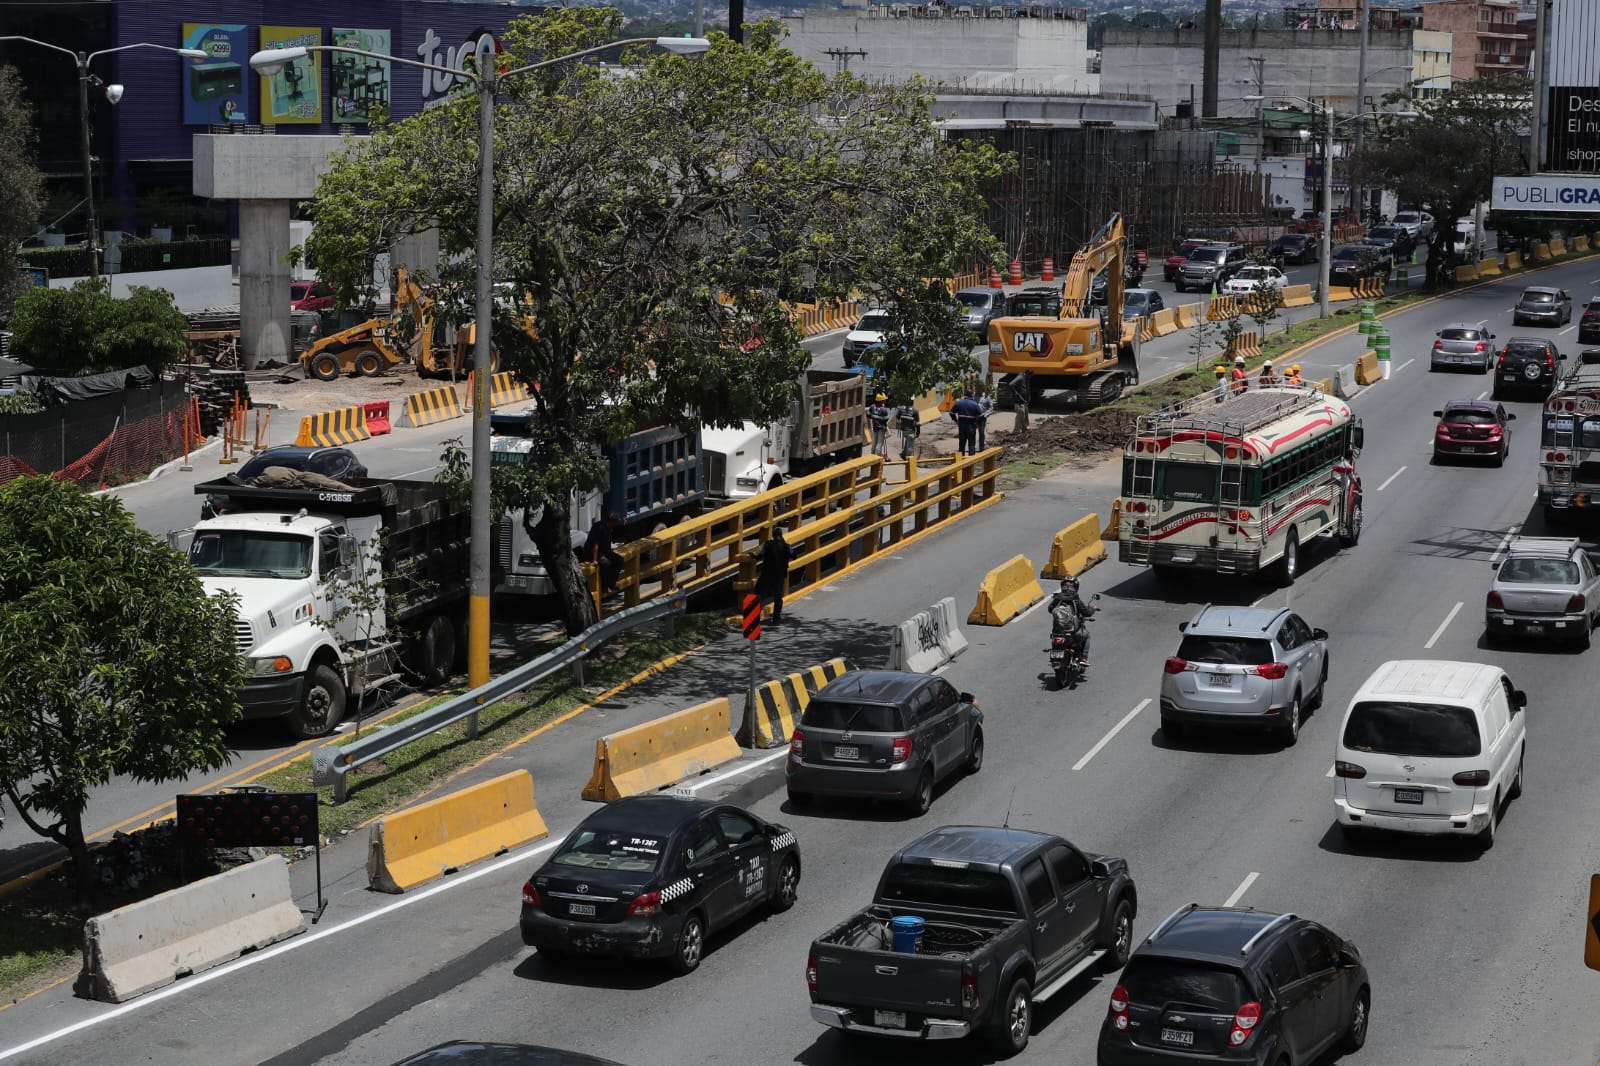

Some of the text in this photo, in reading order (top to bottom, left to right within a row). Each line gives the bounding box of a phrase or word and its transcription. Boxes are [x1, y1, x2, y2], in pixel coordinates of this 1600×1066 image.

[1569, 95, 1600, 112] Des
[1568, 119, 1581, 133] El
[1503, 187, 1600, 203] PUBLIGRA
[1014, 332, 1044, 352] CAT
[631, 838, 658, 846] TR-1367
[749, 855, 760, 870] TAXI
